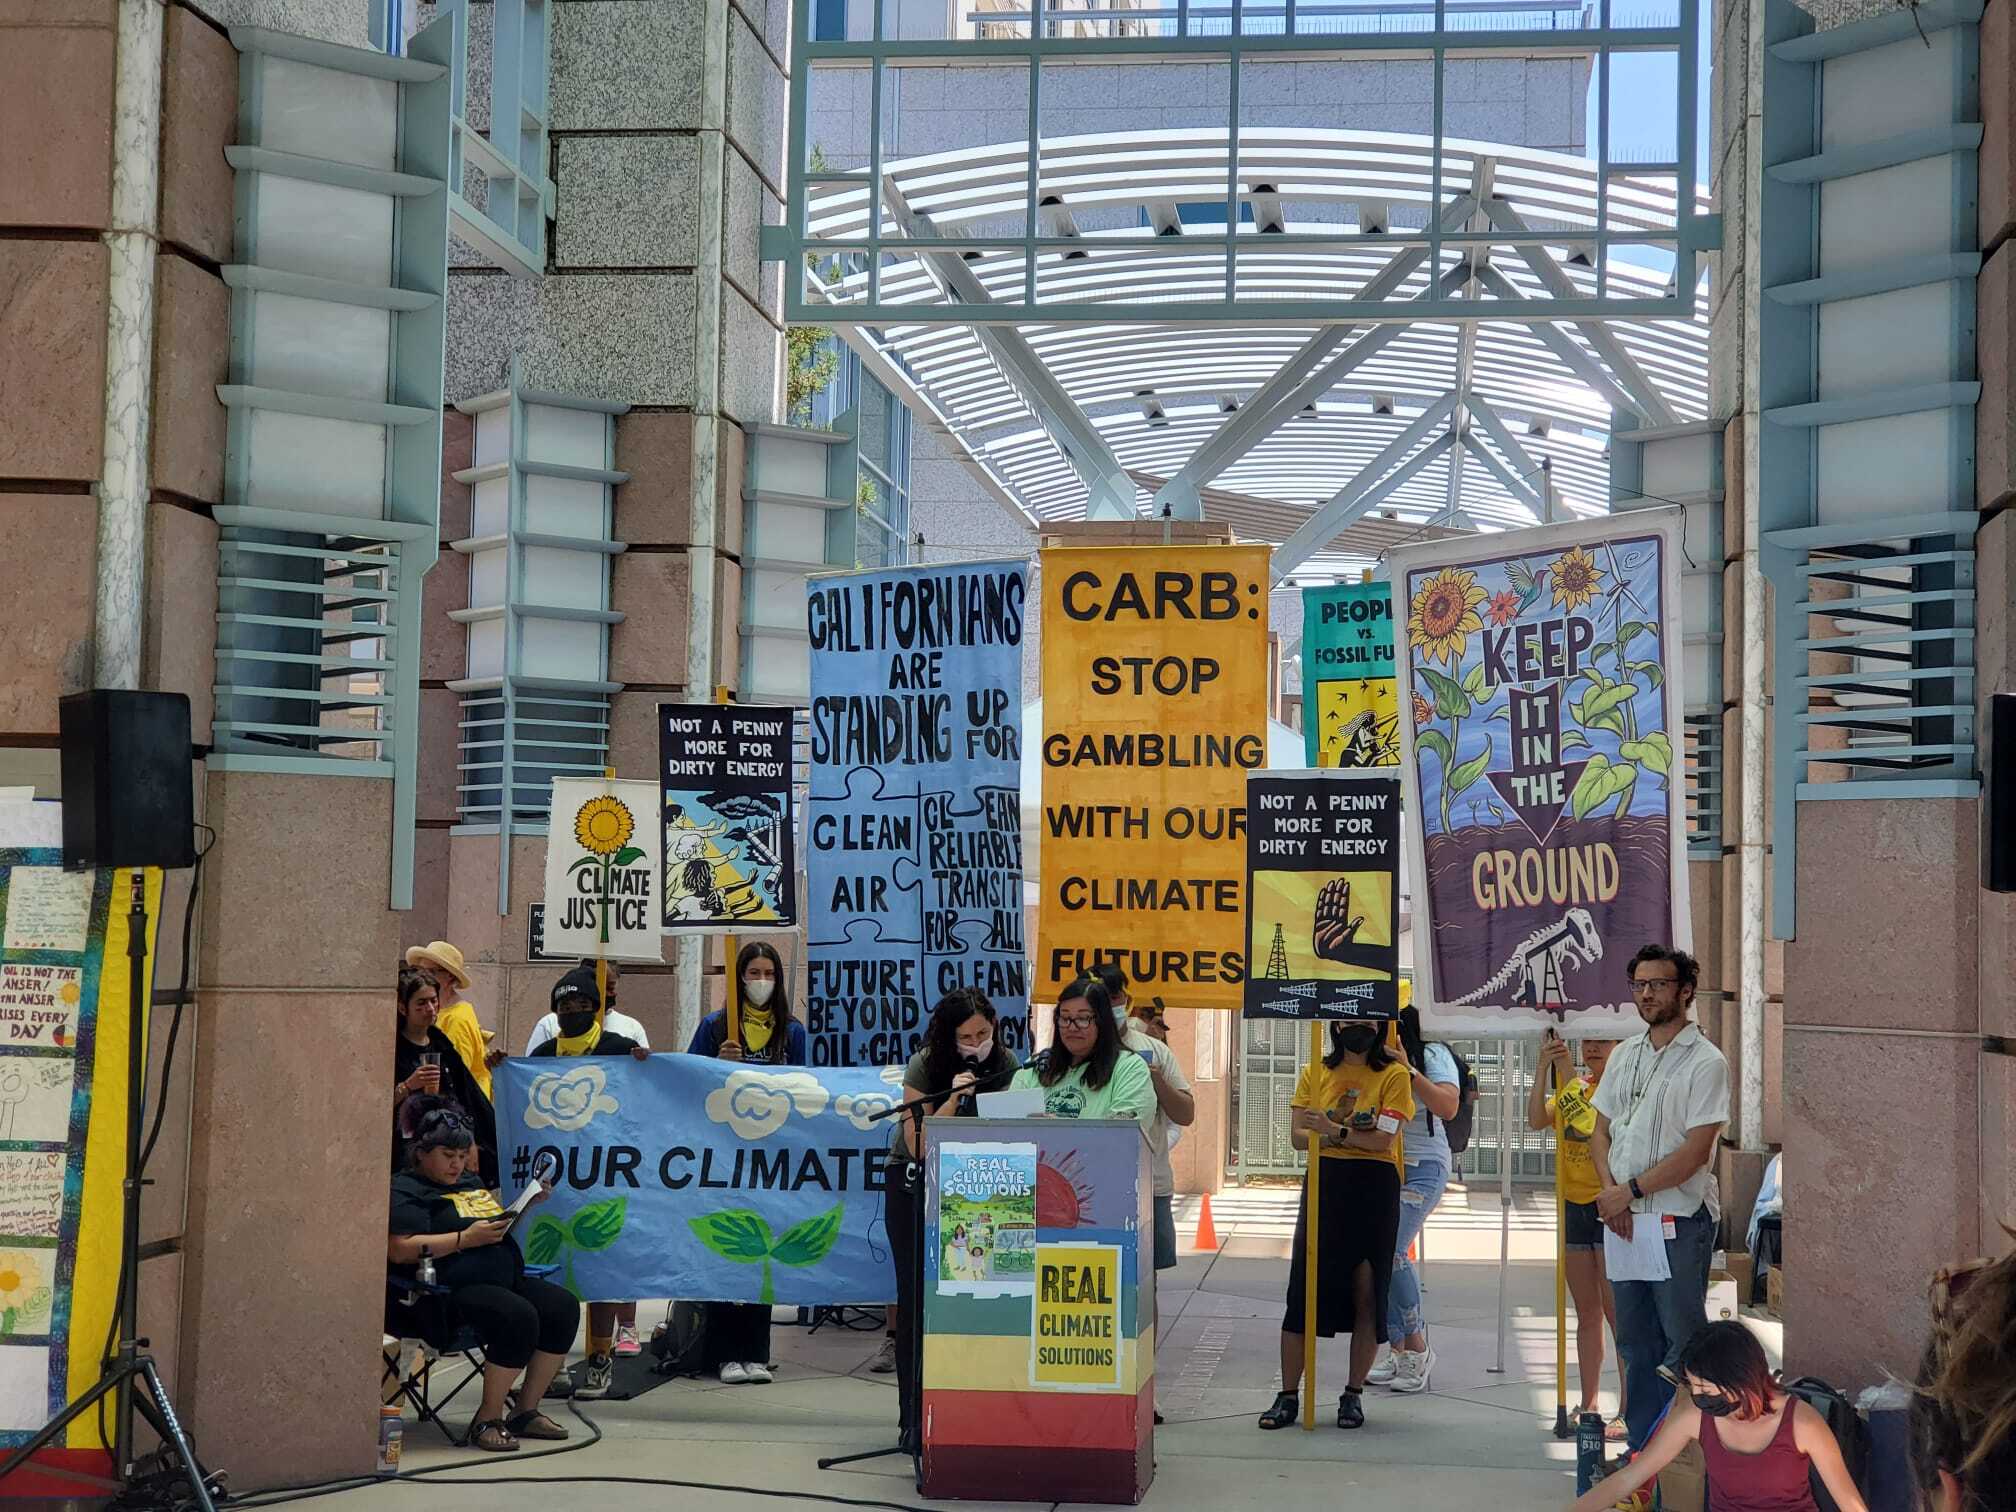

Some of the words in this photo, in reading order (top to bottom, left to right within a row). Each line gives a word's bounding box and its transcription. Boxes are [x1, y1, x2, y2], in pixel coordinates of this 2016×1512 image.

[808, 572, 1025, 651] CALIFORNIANS
[1062, 571, 1259, 621] CARB:
[889, 652, 942, 689] ARE
[1315, 648, 1370, 665] FOSSIL
[1482, 617, 1595, 688] KEEP
[1091, 656, 1220, 695] STOP
[669, 718, 702, 734] NOT
[711, 720, 723, 734] A
[732, 720, 784, 736] PENNY
[811, 694, 953, 766] STANDING
[967, 689, 1009, 727] UP
[1521, 695, 1550, 729] IT
[684, 740, 727, 755] MORE
[739, 742, 773, 757] FOR
[966, 725, 1020, 761] FOR
[1042, 734, 1264, 768] GAMBLING
[1522, 732, 1554, 766] IN
[669, 759, 715, 776] DIRTY
[726, 760, 784, 777] ENERGY
[1260, 794, 1294, 810] NOT
[1305, 795, 1317, 811] A
[1329, 794, 1388, 811] PENNY
[1511, 774, 1567, 808] THE
[813, 814, 911, 850] CLEAN
[1047, 804, 1149, 839] WITH
[1164, 807, 1247, 840] OUR
[1274, 818, 1322, 833] MORE
[1335, 818, 1373, 834] FOR
[928, 830, 1023, 870] RELIABLE
[1260, 839, 1308, 855] DIRTY
[1321, 839, 1388, 855] ENERGY
[831, 876, 889, 913] AIR
[931, 870, 1021, 909] TRANSIT
[1059, 876, 1239, 913] CLIMATE
[1472, 842, 1621, 911] GROUND
[559, 898, 647, 930] JUSTICE
[924, 910, 964, 952] FOR
[991, 909, 1022, 951] ALL
[807, 959, 915, 998] FUTURE
[937, 960, 1025, 997] CLEAN
[1050, 948, 1244, 984] FUTURES
[10, 1023, 44, 1040] DAY
[807, 997, 919, 1034] BEYOND
[812, 1035, 858, 1067] OIL
[512, 1145, 642, 1190] #OUR
[658, 1147, 889, 1192] CLIMATE
[952, 1171, 1025, 1184] CLIMATE
[967, 1158, 1011, 1171] REAL
[943, 1181, 1031, 1197] SOLUTIONS
[1041, 1265, 1113, 1304] REAL
[1039, 1314, 1112, 1338] CLIMATE
[1038, 1347, 1113, 1366] SOLUTIONS
